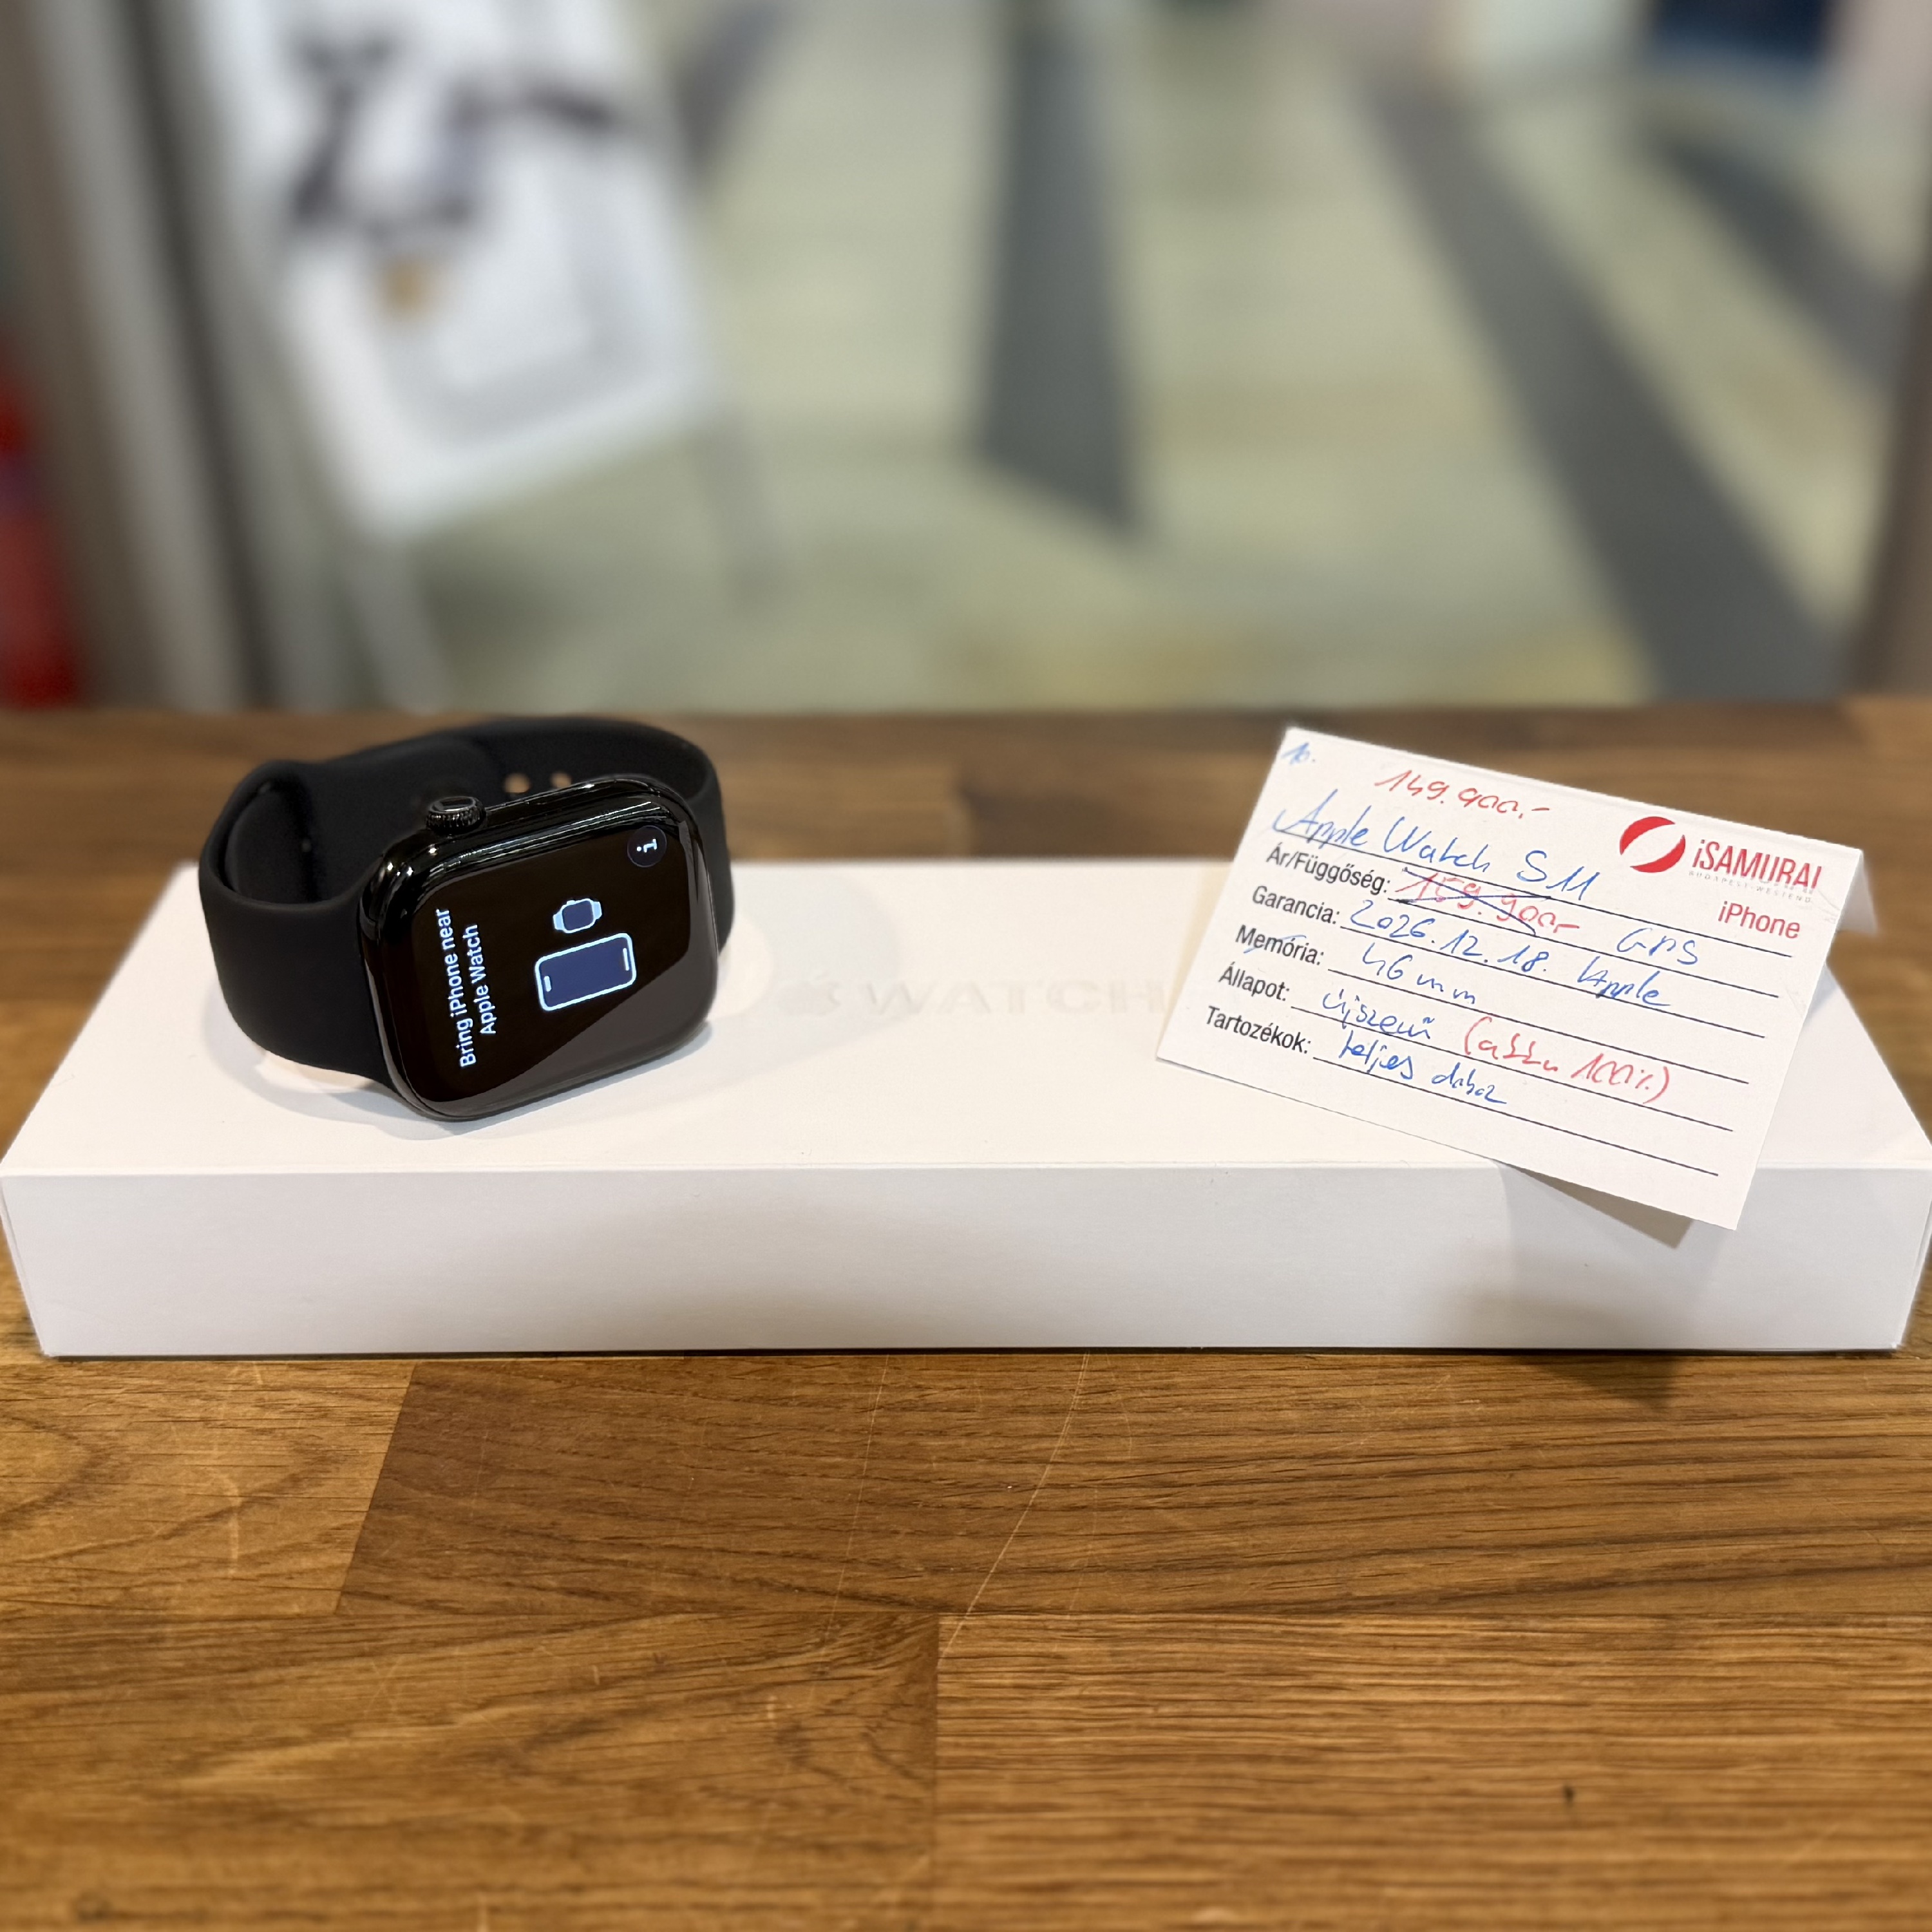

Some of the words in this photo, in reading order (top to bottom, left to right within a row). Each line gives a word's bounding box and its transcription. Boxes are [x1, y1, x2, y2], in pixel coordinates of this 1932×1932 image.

[1272, 788, 1372, 849] Apple
[1383, 816, 1491, 873] Watch
[1265, 842, 1392, 895] Ár/Függőség:
[1691, 838, 1823, 889] iSAMURAI
[436, 908, 456, 951] near
[1251, 885, 1340, 925] Garancia:
[1717, 900, 1801, 940] iPhone
[462, 924, 486, 985] Watch
[1235, 924, 1325, 966] Memória:
[446, 953, 468, 1018] iPhone
[1218, 961, 1290, 1002] Állapot:
[473, 985, 497, 1035] Apple
[1206, 1005, 1312, 1055] Tartozékok:
[456, 1017, 477, 1068] Bring
